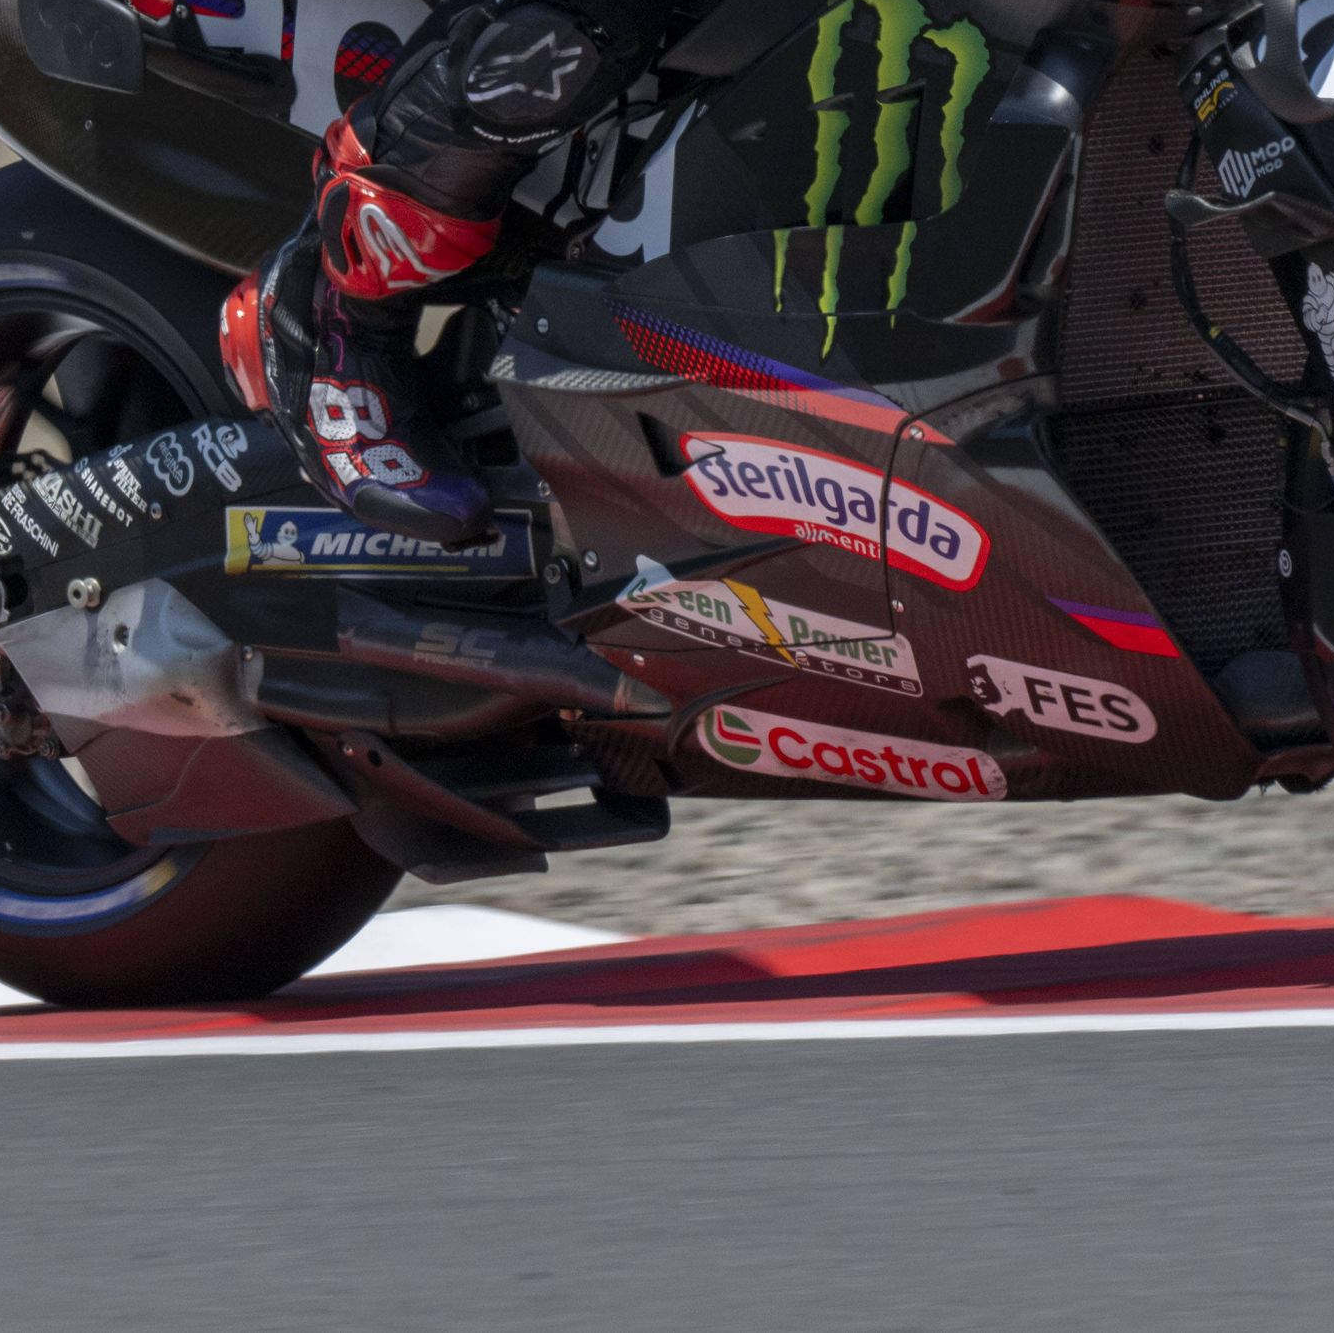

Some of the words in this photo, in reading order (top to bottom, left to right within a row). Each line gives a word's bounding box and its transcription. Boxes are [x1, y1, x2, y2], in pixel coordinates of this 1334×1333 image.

[1251, 136, 1296, 165] MOD
[1256, 158, 1283, 178] MOD
[81, 467, 134, 529] SHAREBOT
[111, 473, 148, 515] FILTER
[112, 457, 143, 493] SPRINT
[697, 454, 962, 561] sterilgarda
[794, 522, 882, 561] alimenti
[626, 578, 734, 626] Green
[414, 621, 509, 659] SC
[648, 607, 918, 693] genetors
[787, 614, 900, 669] Power
[1022, 674, 1140, 733] FES
[767, 726, 991, 795] Castrol
